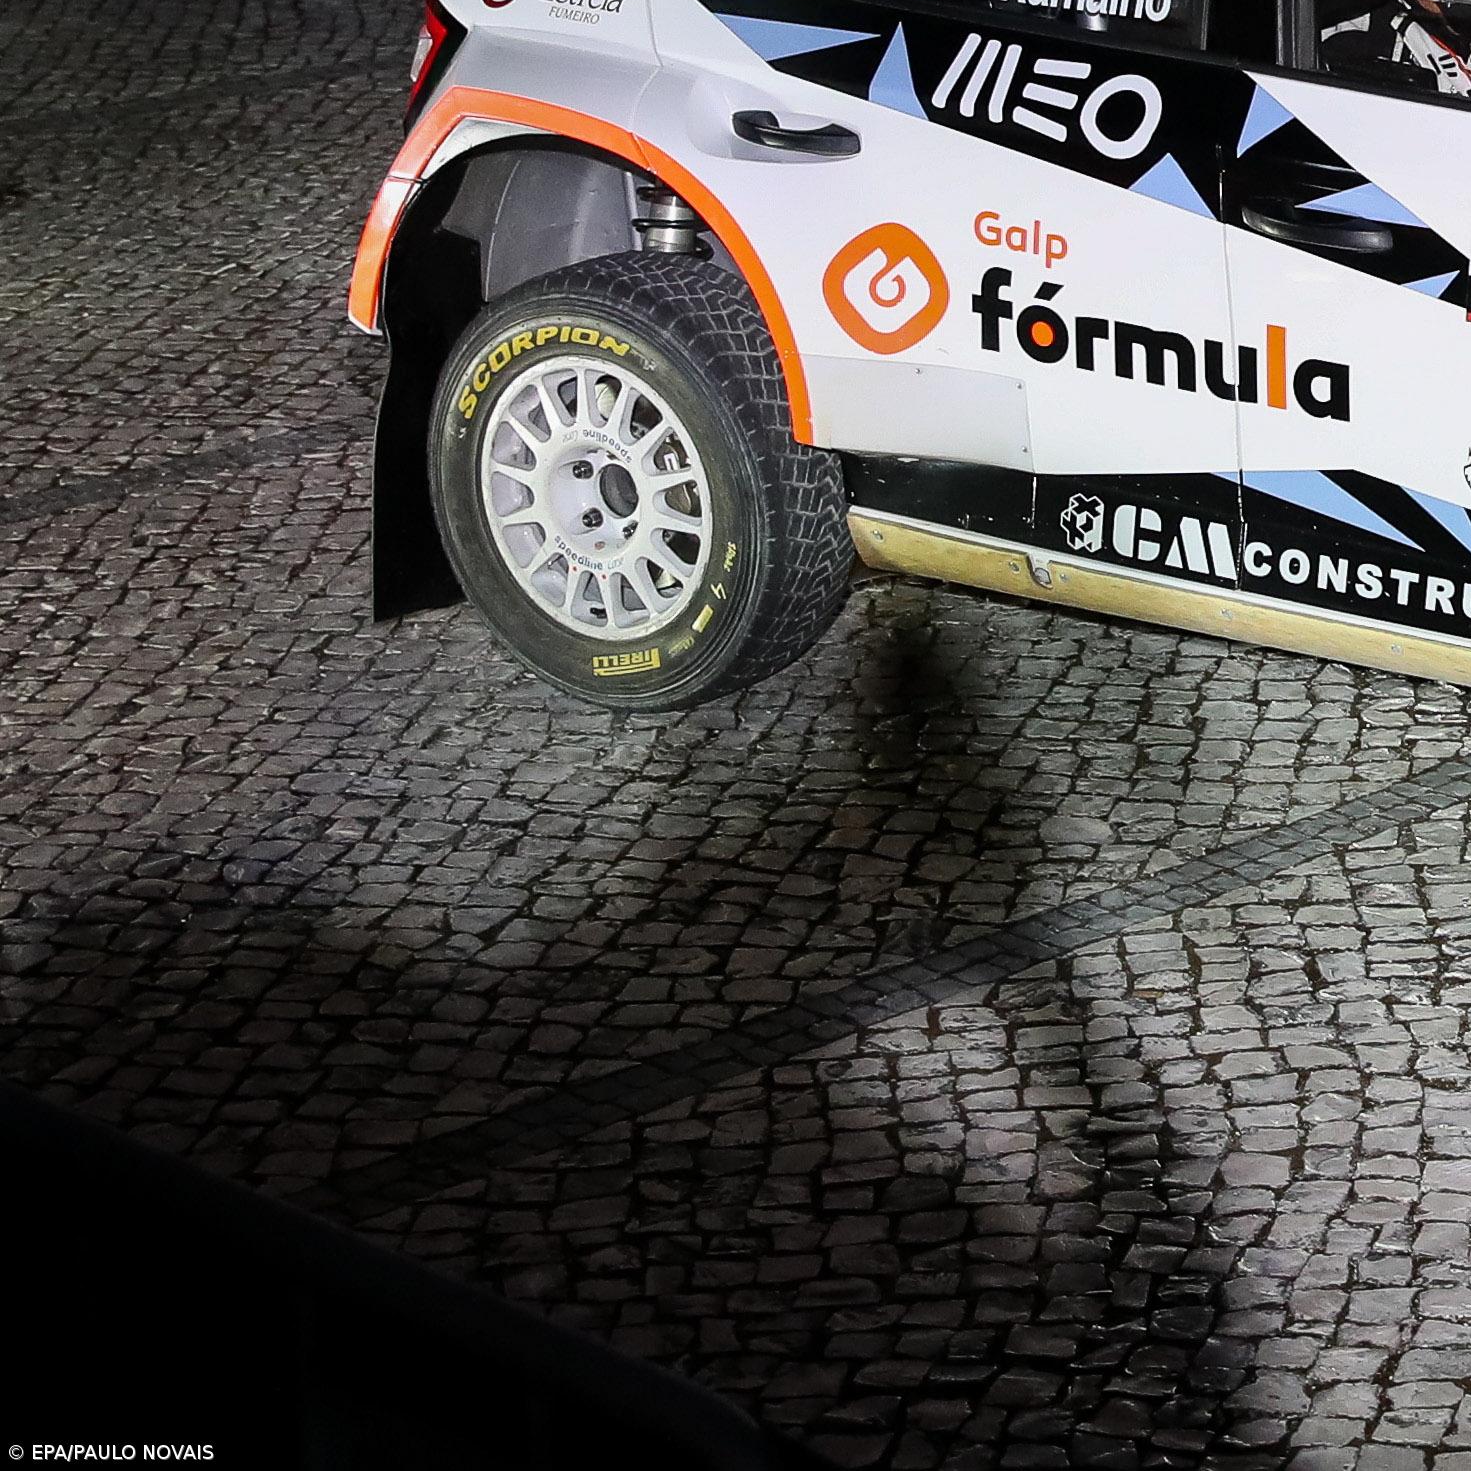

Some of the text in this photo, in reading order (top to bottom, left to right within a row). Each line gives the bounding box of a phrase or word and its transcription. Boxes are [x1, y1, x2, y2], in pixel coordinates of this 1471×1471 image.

[548, 6, 600, 25] FUMEIRO
[931, 33, 1163, 160] MEO
[974, 210, 1069, 268] Galp
[457, 326, 631, 420] SCORPION
[971, 267, 1351, 422] fórmula
[592, 647, 661, 677] PIRELLI
